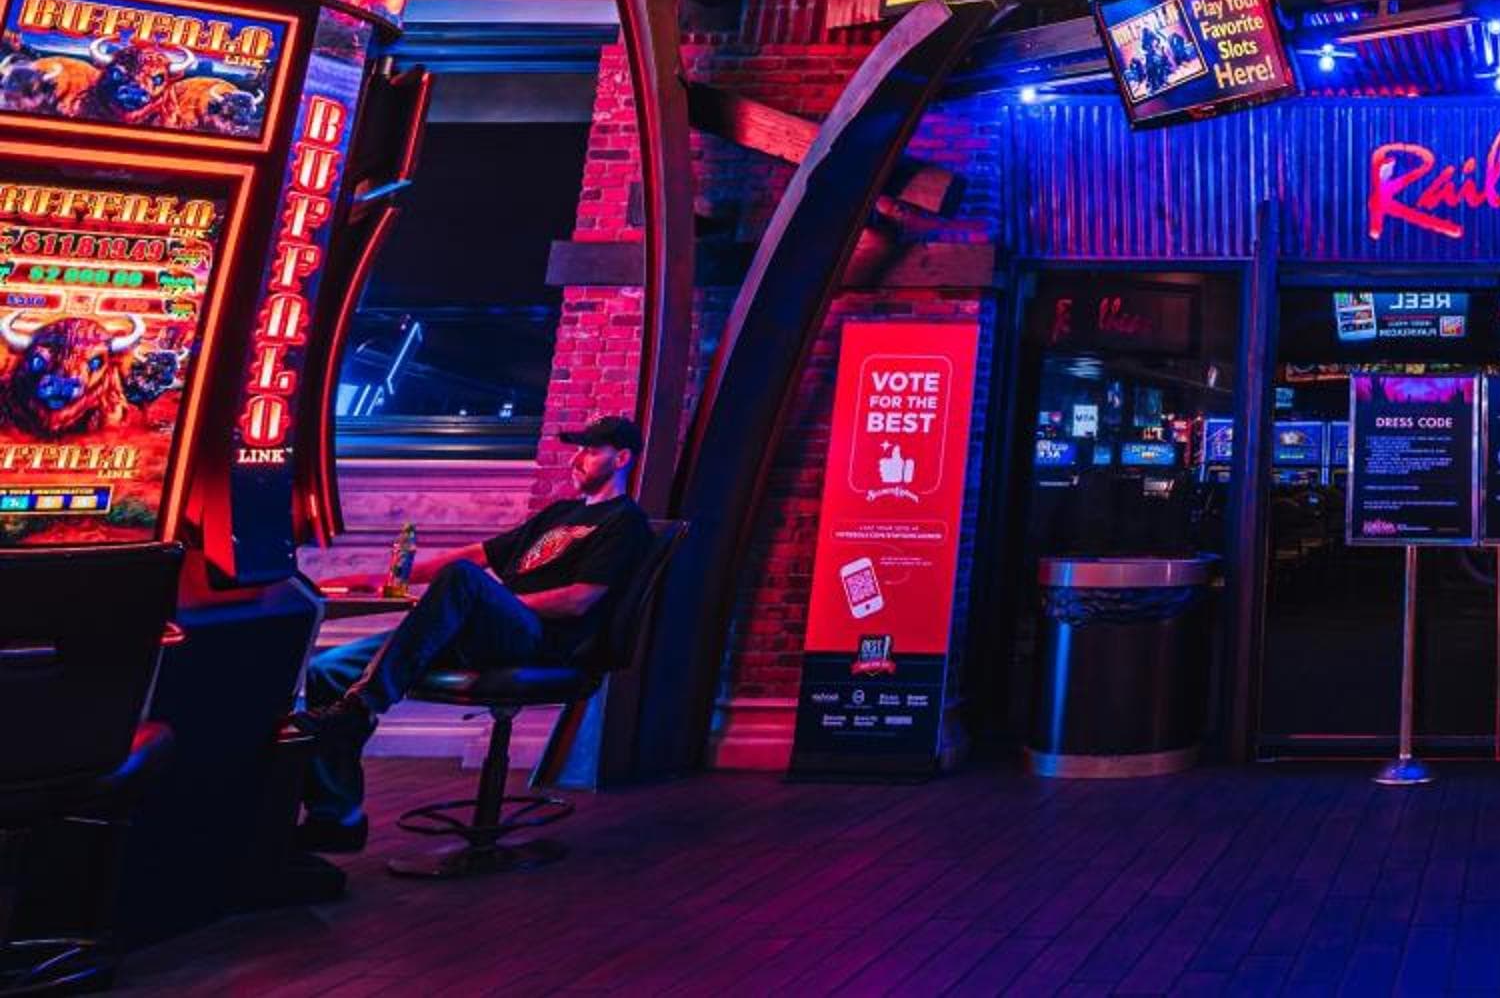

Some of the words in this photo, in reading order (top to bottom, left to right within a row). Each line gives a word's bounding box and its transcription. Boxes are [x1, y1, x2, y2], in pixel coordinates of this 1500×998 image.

[1201, 15, 1264, 40] Favorite
[1217, 40, 1259, 59] Slots
[1214, 54, 1276, 89] Here!
[240, 94, 347, 446] BUFFALO
[871, 371, 941, 393] VOTE
[868, 395, 903, 409] FOR
[907, 395, 938, 409] THE
[866, 412, 937, 434] BEST
[1375, 417, 1414, 428] DRESS
[1417, 417, 1454, 428] CODE
[237, 448, 286, 464] LINK
